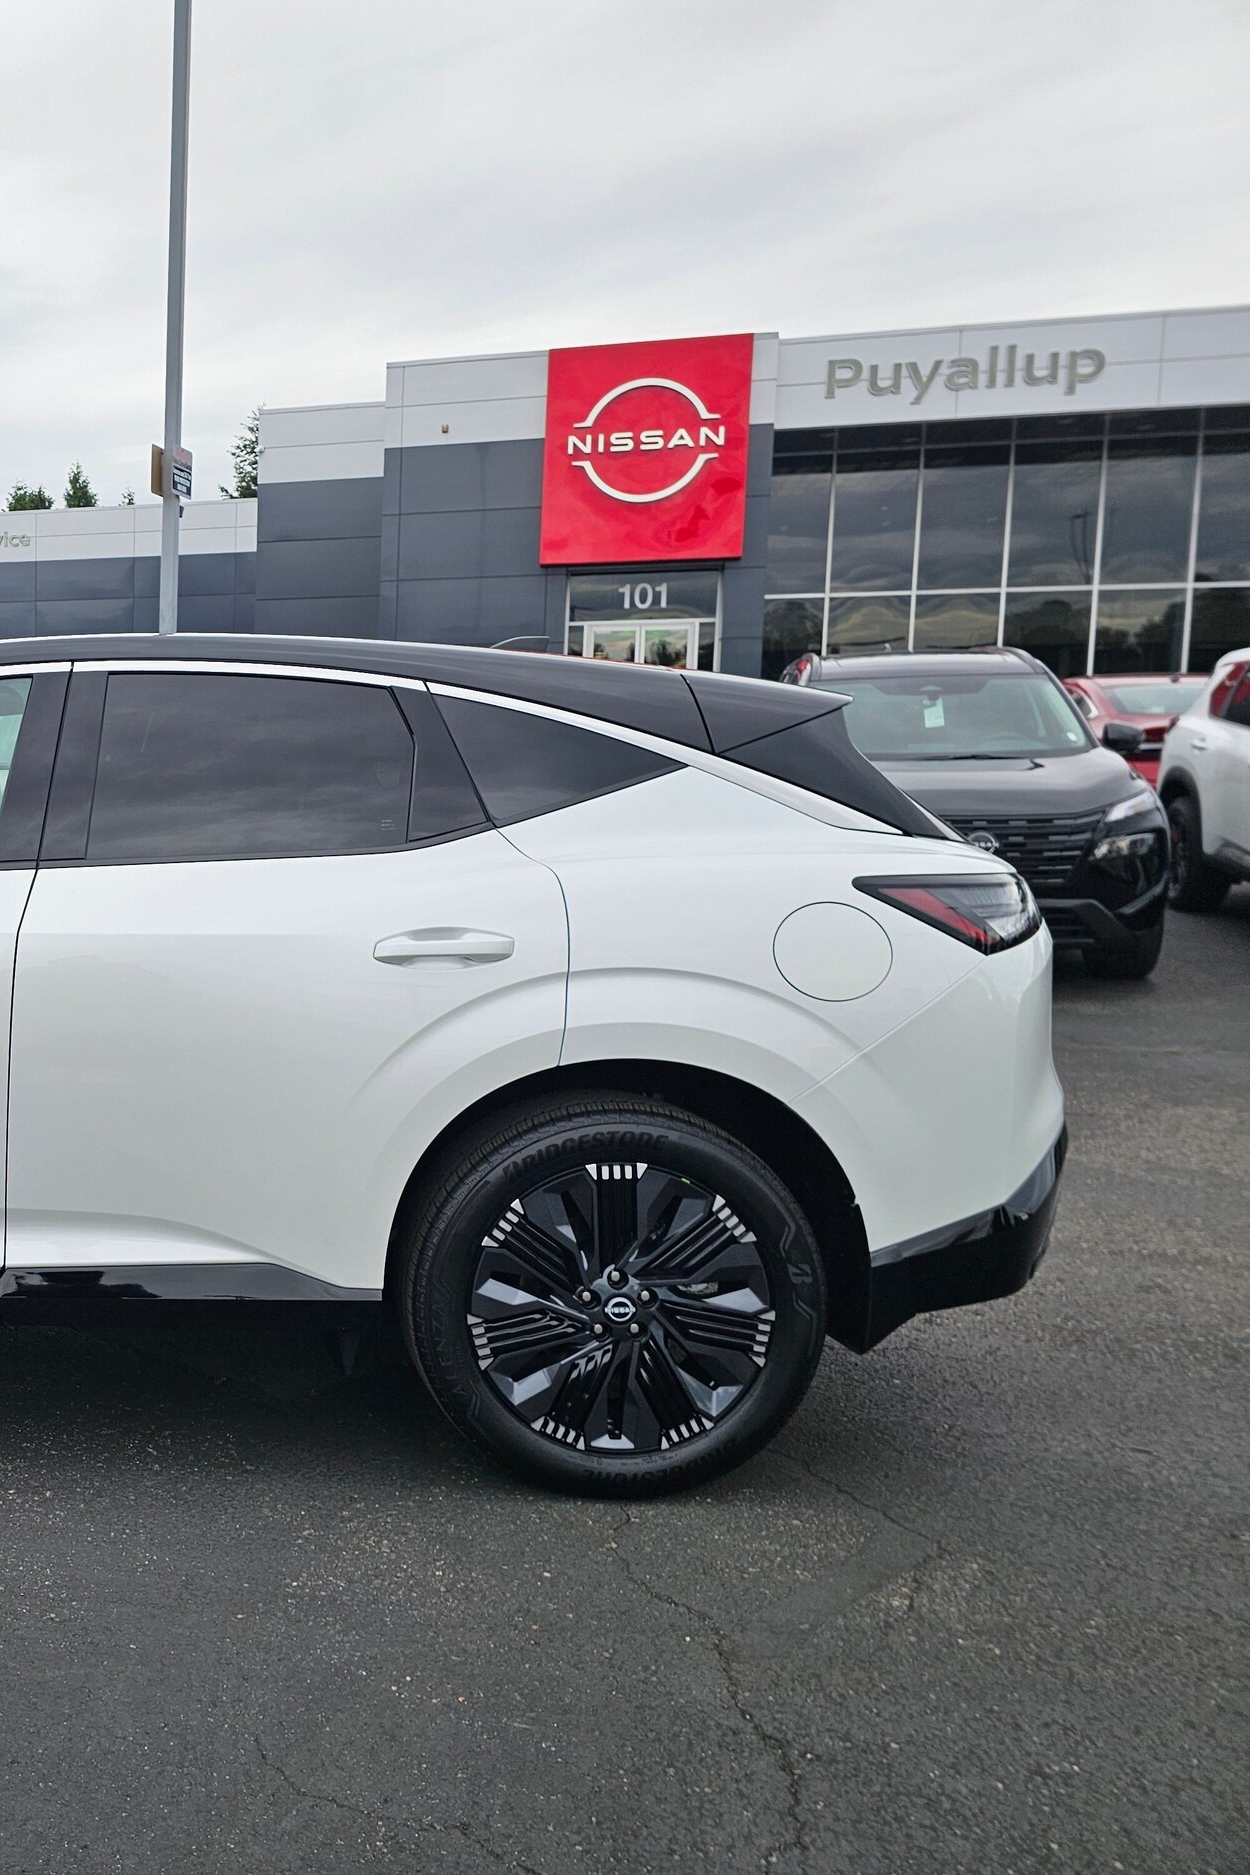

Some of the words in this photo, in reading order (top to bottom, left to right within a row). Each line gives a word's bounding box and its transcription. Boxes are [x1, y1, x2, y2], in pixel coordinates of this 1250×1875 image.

[824, 344, 1107, 405] Puyallup
[566, 424, 726, 456] NISSAN
[618, 582, 668, 610] 101
[501, 1130, 670, 1180] BRIDGESTONE
[431, 1300, 469, 1397] ALENZA
